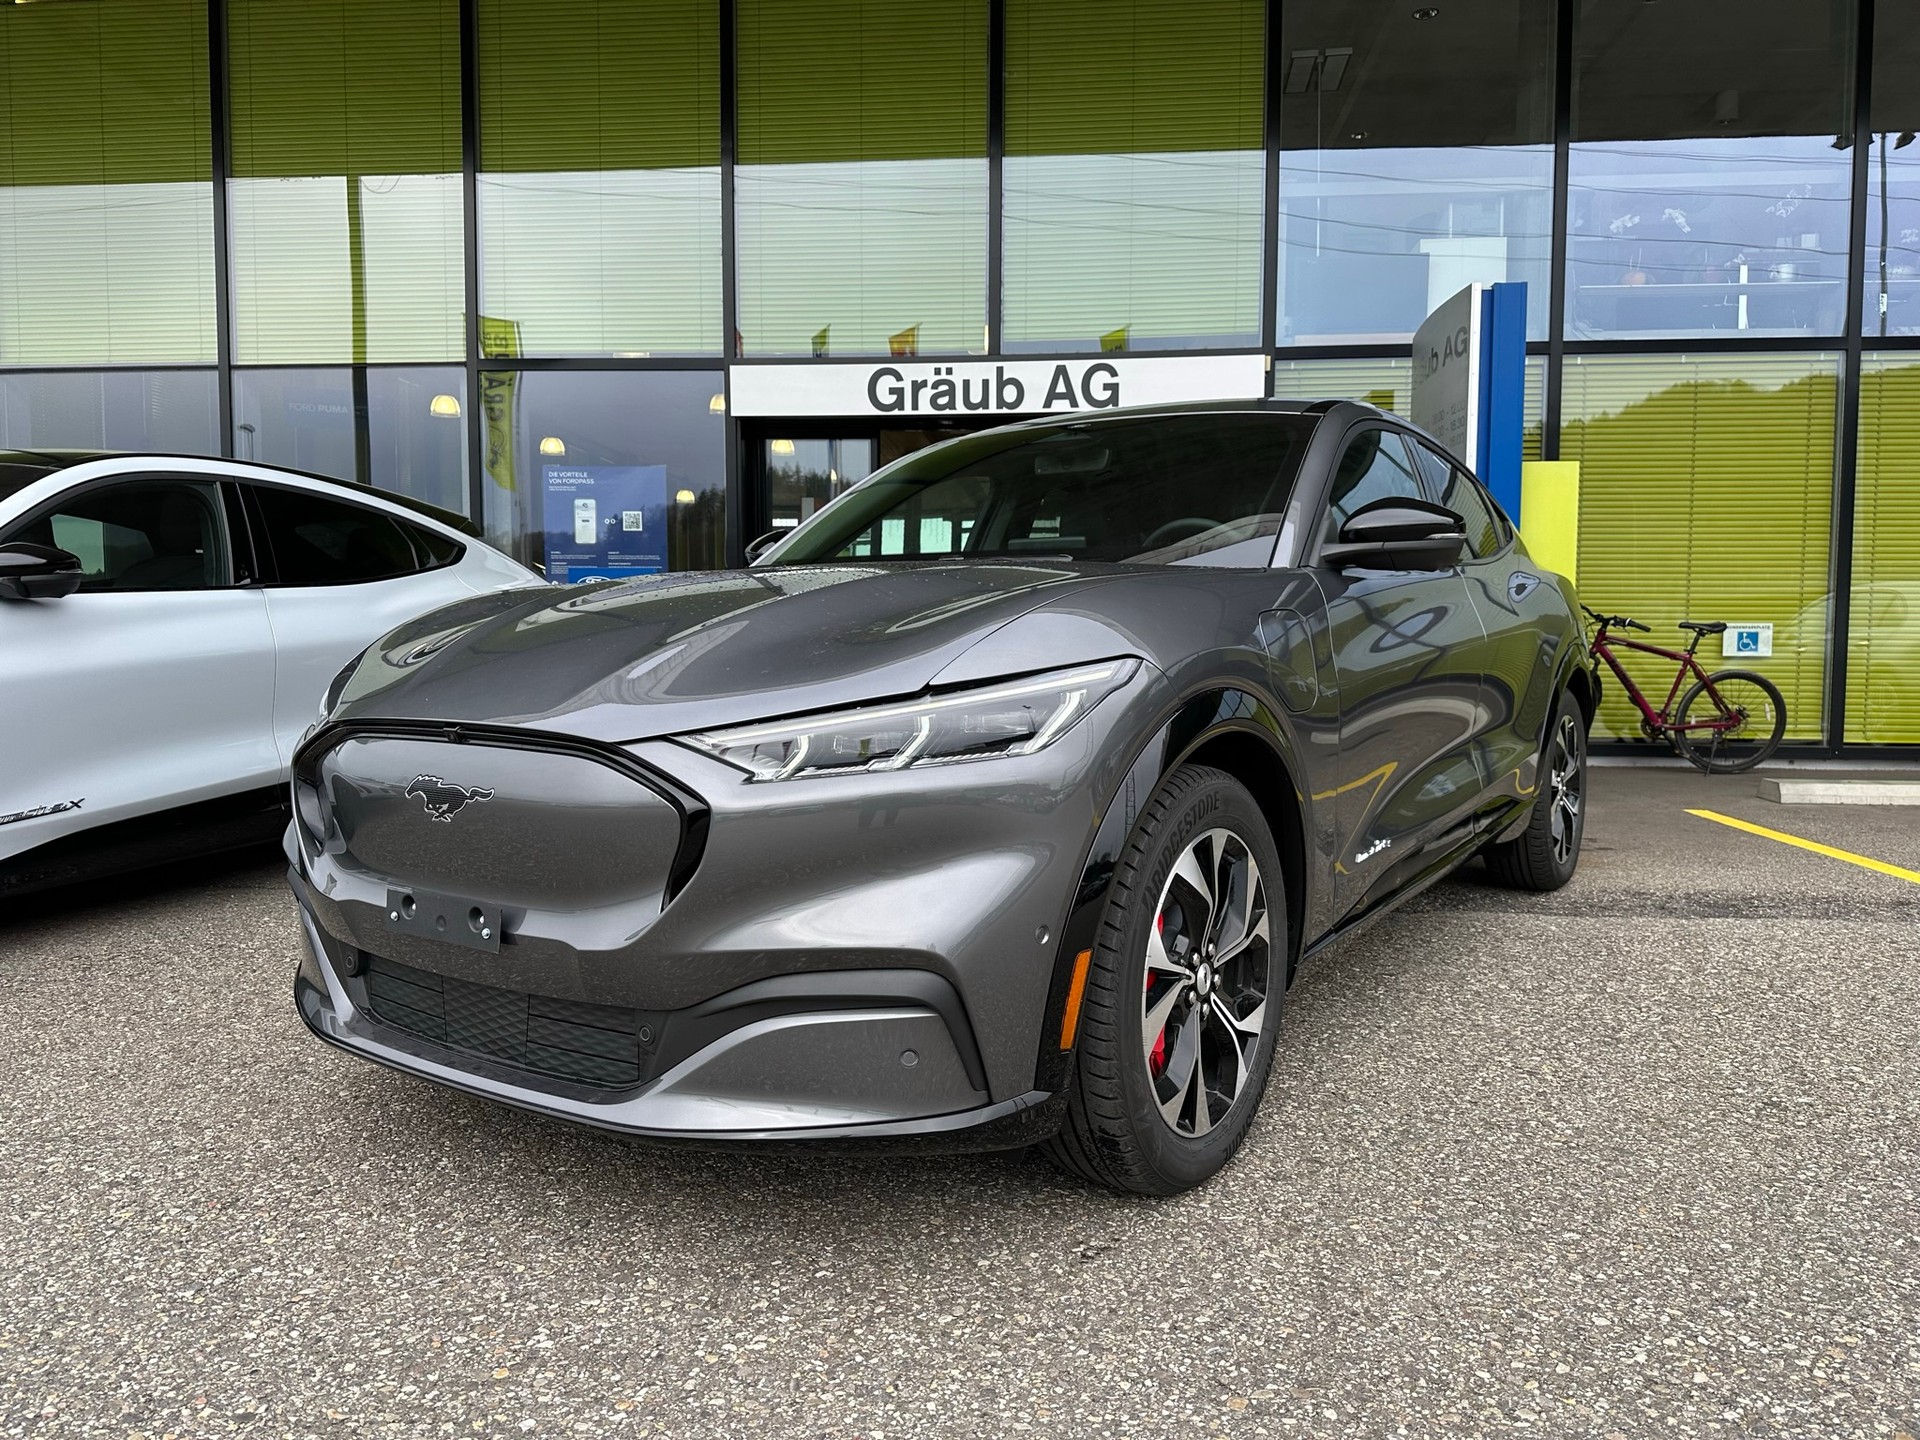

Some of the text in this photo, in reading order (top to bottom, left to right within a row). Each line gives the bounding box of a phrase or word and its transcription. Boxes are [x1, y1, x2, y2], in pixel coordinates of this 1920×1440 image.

[1442, 326, 1467, 367] AG
[289, 402, 348, 414] FORD PUMA
[867, 363, 1120, 412] Gräub AG
[1142, 790, 1220, 916] BRIDGESTONE
